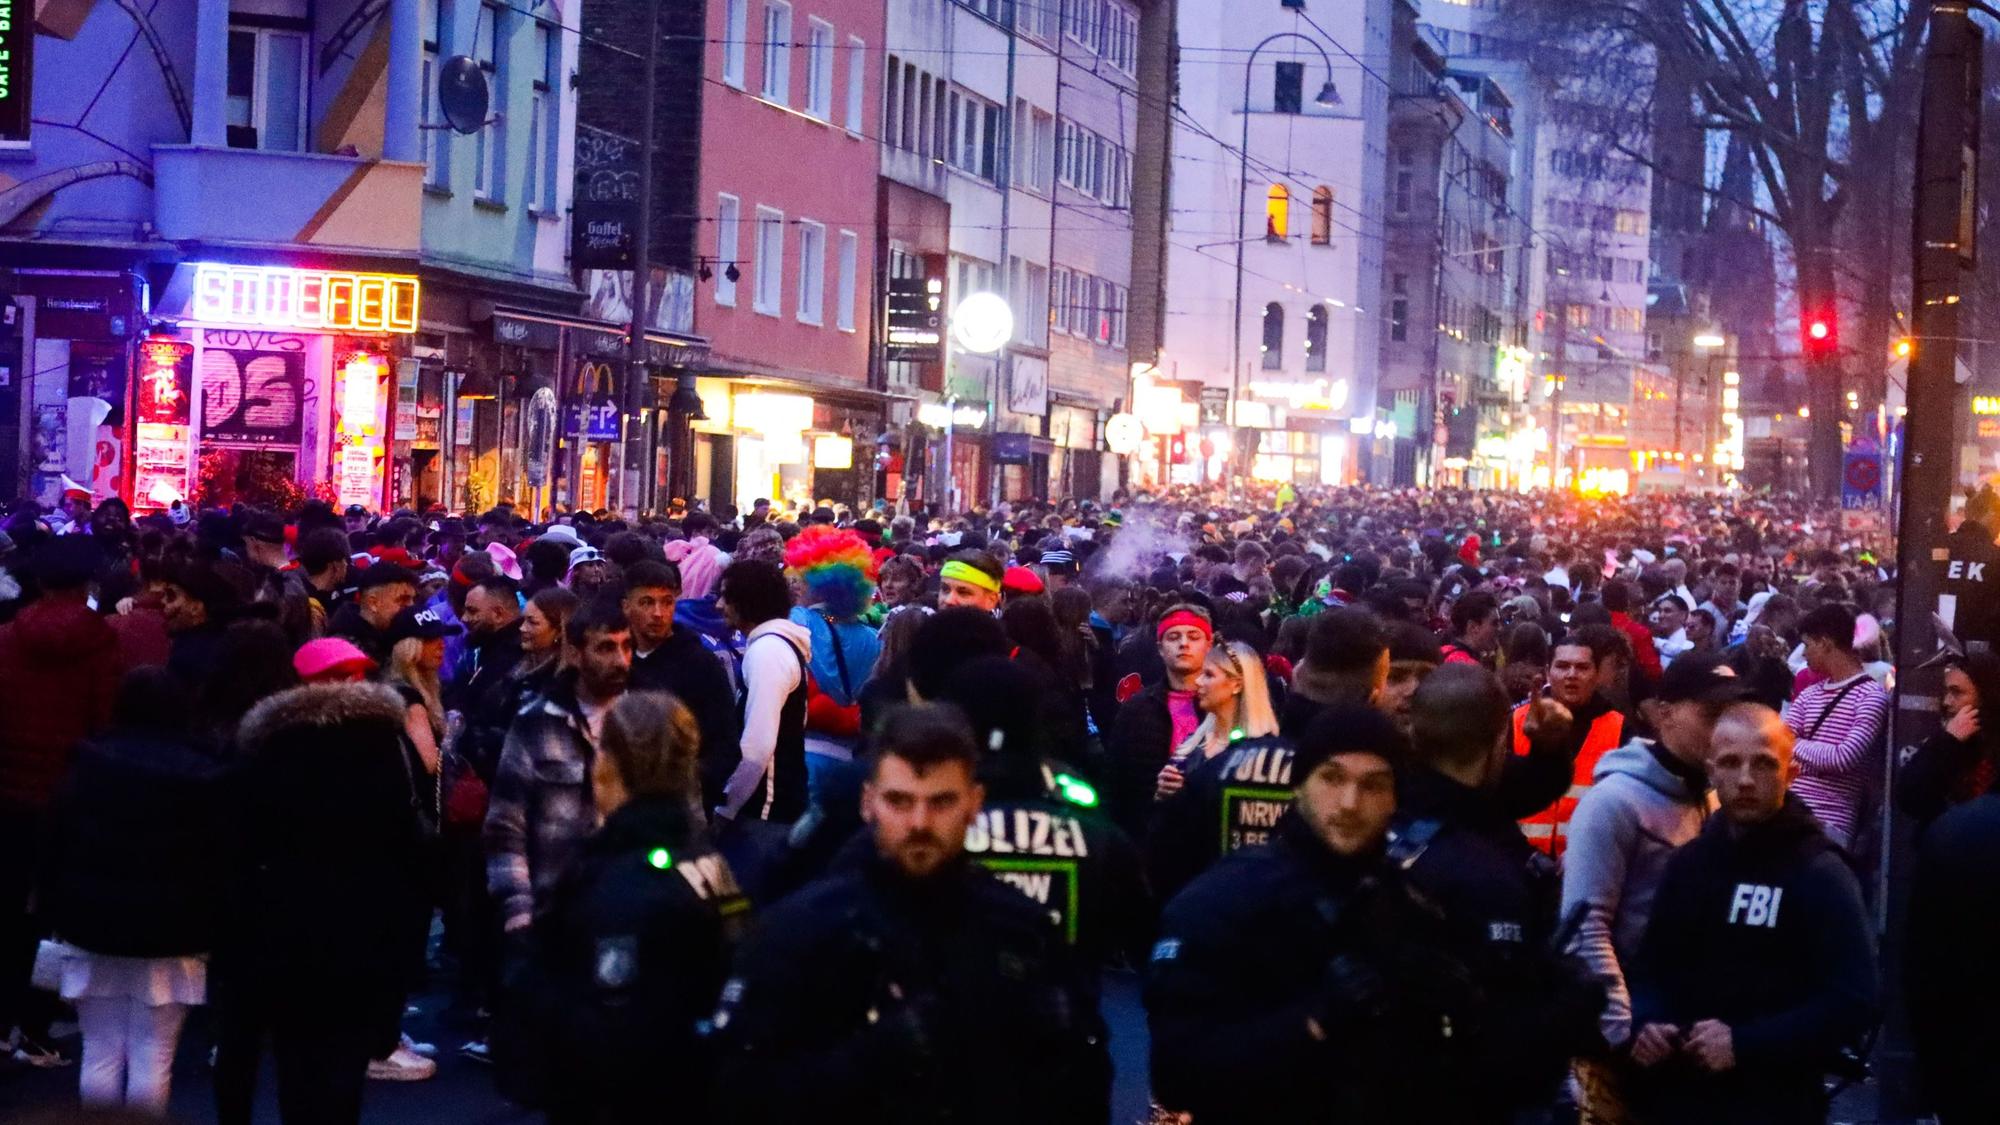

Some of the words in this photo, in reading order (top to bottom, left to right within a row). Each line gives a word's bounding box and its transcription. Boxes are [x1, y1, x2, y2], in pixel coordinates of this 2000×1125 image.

[588, 221, 622, 235] Gaffel
[200, 268, 416, 330] STIEFEL
[963, 808, 1088, 858] OLIZEI
[1729, 884, 1783, 928] FBI
